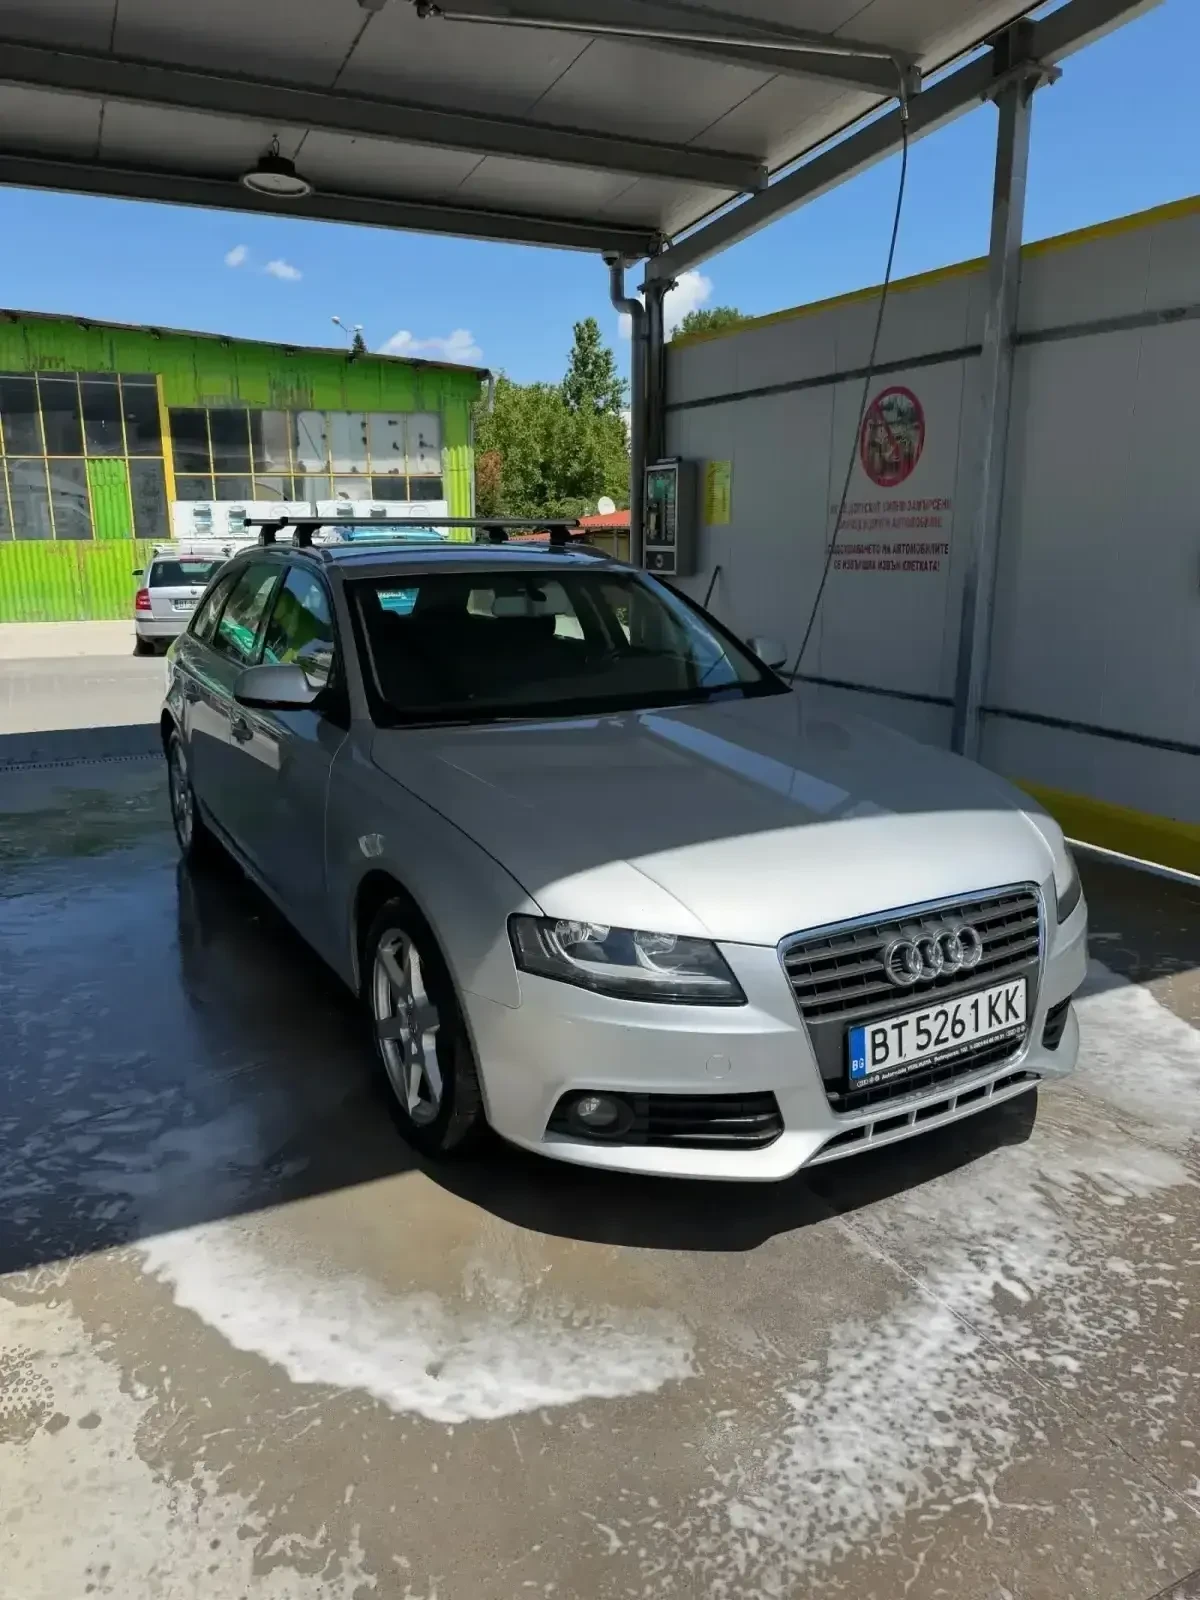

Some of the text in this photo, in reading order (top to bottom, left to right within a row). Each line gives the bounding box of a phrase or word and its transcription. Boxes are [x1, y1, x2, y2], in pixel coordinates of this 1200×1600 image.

[892, 543, 949, 555] АВТОМОБИЛИТЕ
[902, 560, 940, 572] КЛЕТКАТА!
[915, 998, 979, 1051] 5261
[988, 985, 1020, 1028] KK
[852, 1057, 865, 1072] BG
